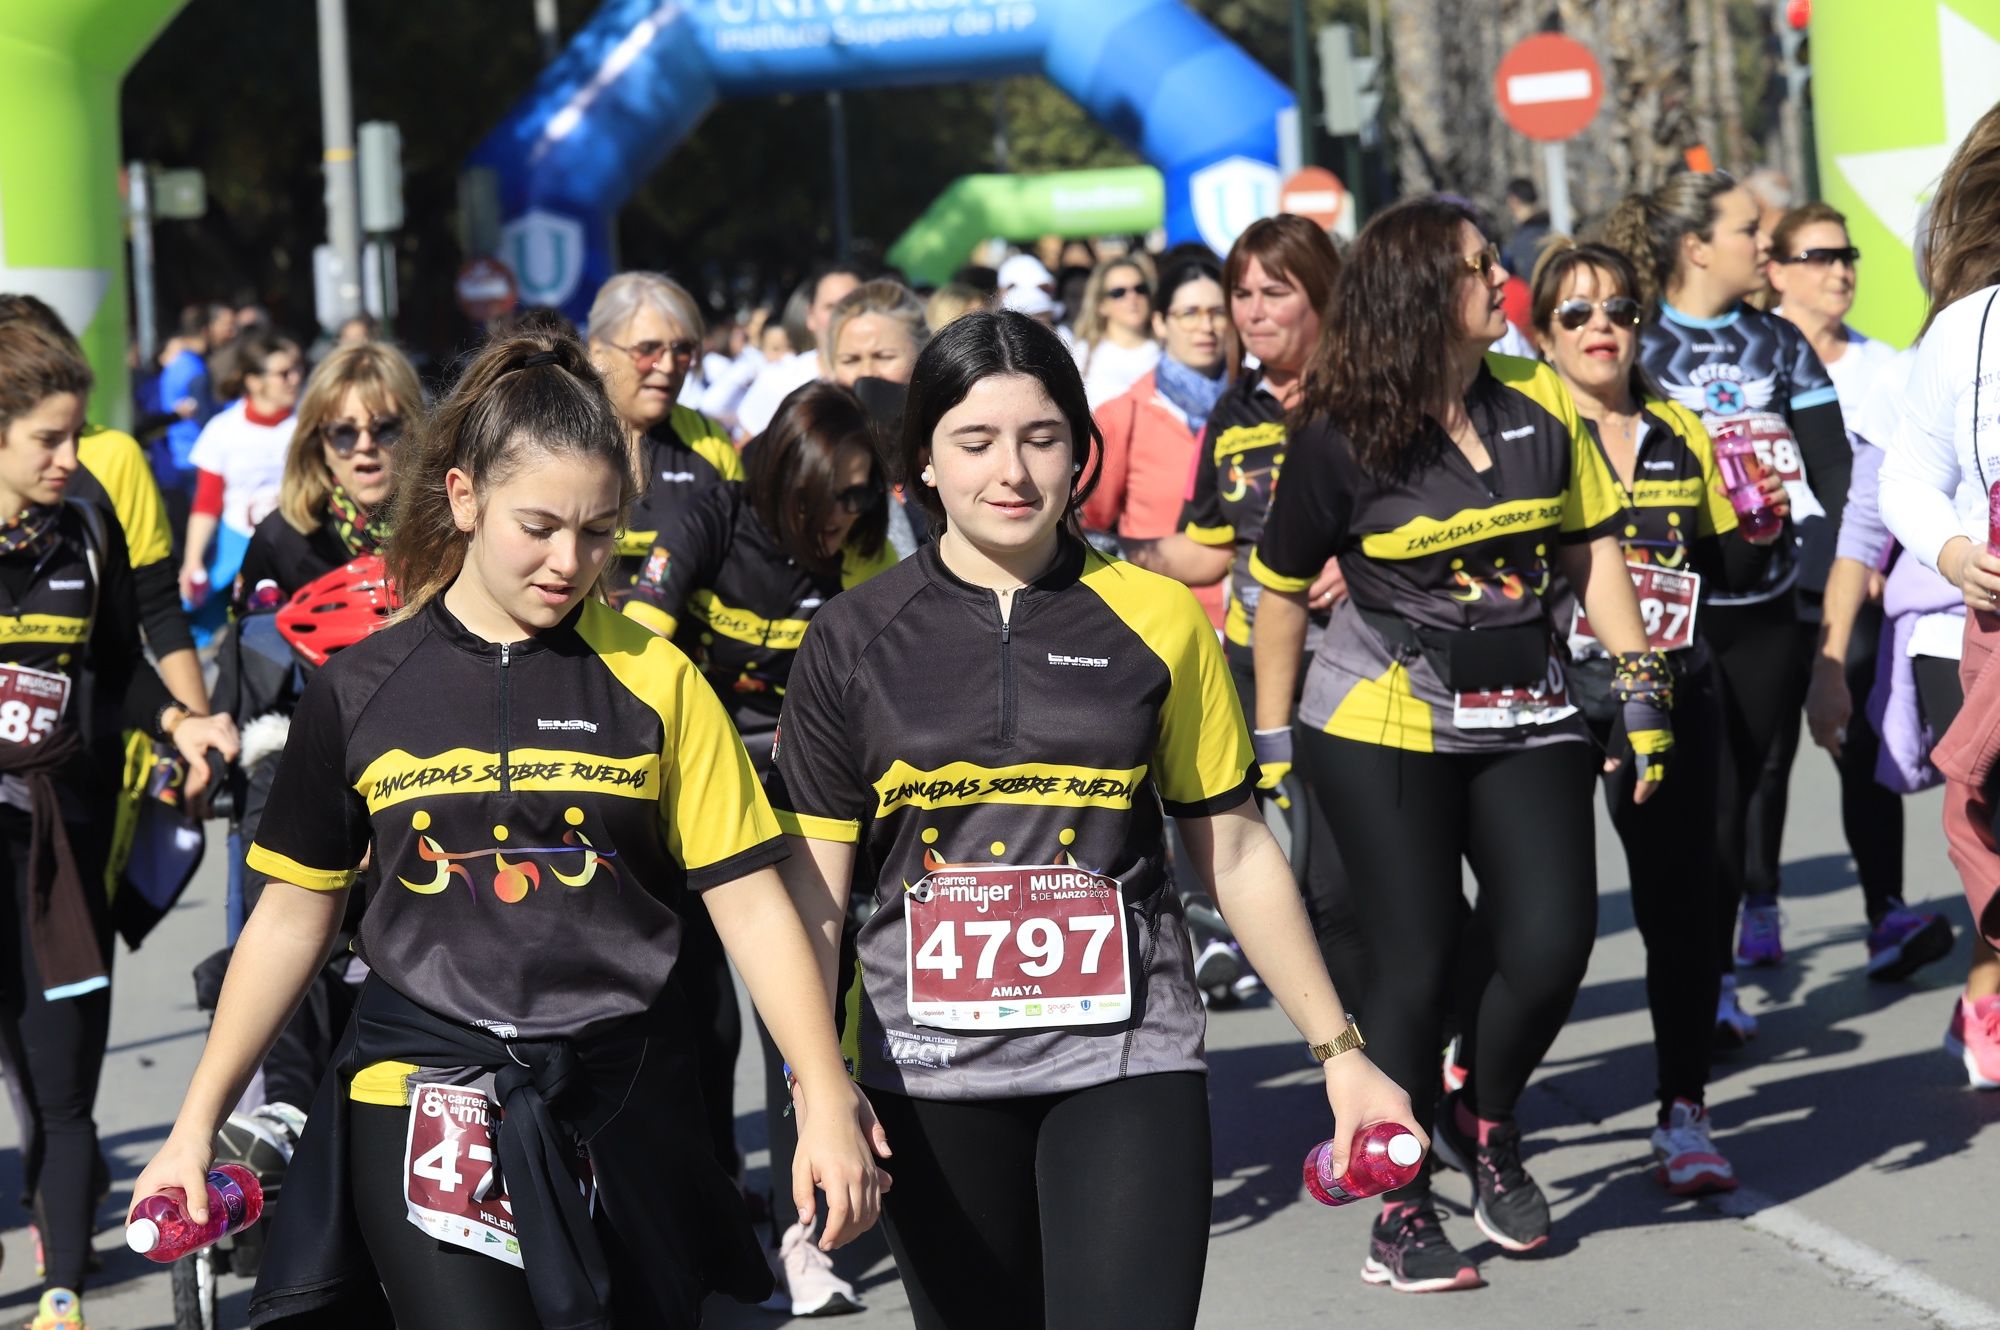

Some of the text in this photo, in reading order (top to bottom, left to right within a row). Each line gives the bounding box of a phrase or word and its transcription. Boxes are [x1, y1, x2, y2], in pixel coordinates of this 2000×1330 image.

[832, 14, 949, 47] Superior
[953, 10, 993, 37] de
[996, 3, 1036, 32] FP
[1752, 437, 1798, 473] 58
[1405, 520, 1483, 551] ZANCADAS
[1485, 509, 1534, 531] SOBRE
[1640, 597, 1690, 641] 87
[0, 699, 58, 744] 85
[374, 761, 649, 800] ZANCADAS SOBRE RUEDAS
[883, 774, 1134, 807] ZANCADAS SOBRE RUEDA
[938, 875, 977, 886] carrera
[1031, 890, 1110, 901] 5 DE MARZO 2023
[949, 884, 1014, 913] mujer
[916, 914, 1115, 980] 4797
[991, 984, 1042, 998] AMAYA
[886, 1028, 921, 1041] UNIVERSIDAD
[447, 1093, 488, 1110] carrera
[413, 1138, 494, 1204] 47
[480, 1210, 517, 1233] HELEN
